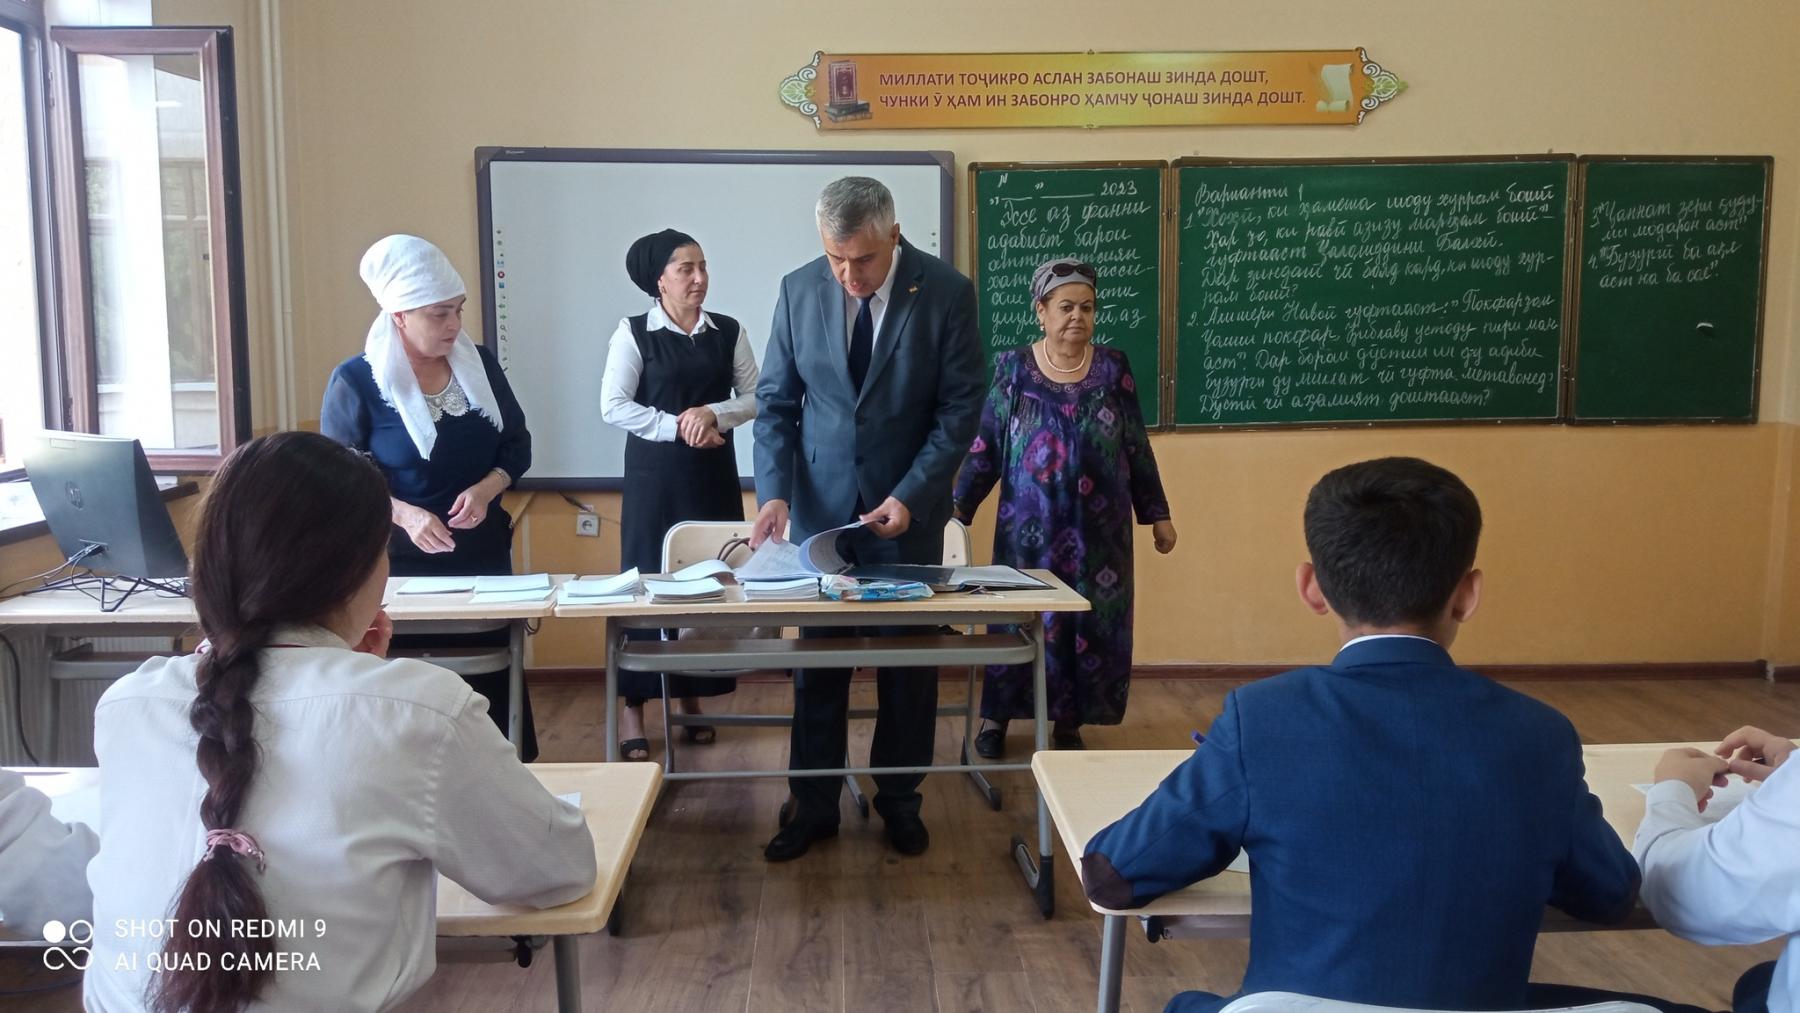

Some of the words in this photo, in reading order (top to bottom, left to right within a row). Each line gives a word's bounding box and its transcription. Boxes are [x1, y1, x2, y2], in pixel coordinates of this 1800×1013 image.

[879, 73, 954, 86] МИЛЛАТИ
[958, 72, 1029, 88] ТОҶИКРО
[1033, 72, 1083, 85] АСЛАН
[1087, 71, 1161, 85] ЗАБОНАШ
[1165, 70, 1216, 85] ЗИНДА
[1220, 70, 1269, 85] ДОШТ,
[879, 95, 929, 108] ЧУНКИ
[933, 92, 943, 107] Ӯ
[947, 94, 981, 109] ҲАМ
[985, 94, 1007, 107] ИН
[1010, 93, 1081, 107] ЗАБОНРО
[1085, 93, 1138, 108] ҲАМЧУ
[1142, 92, 1199, 108] ҶОНАШ
[1202, 92, 1254, 106] ЗИНДА
[1257, 91, 1306, 106] ДОШТ.
[1101, 180, 1138, 196] 2023
[1267, 205, 1289, 219] ки
[1386, 193, 1432, 217] шоду
[1047, 204, 1071, 233] аз
[1276, 226, 1298, 239] ки
[1201, 266, 1239, 292] Дар
[1255, 348, 1293, 373] Дар
[1460, 344, 1483, 367] ду
[1272, 374, 1293, 396] ду
